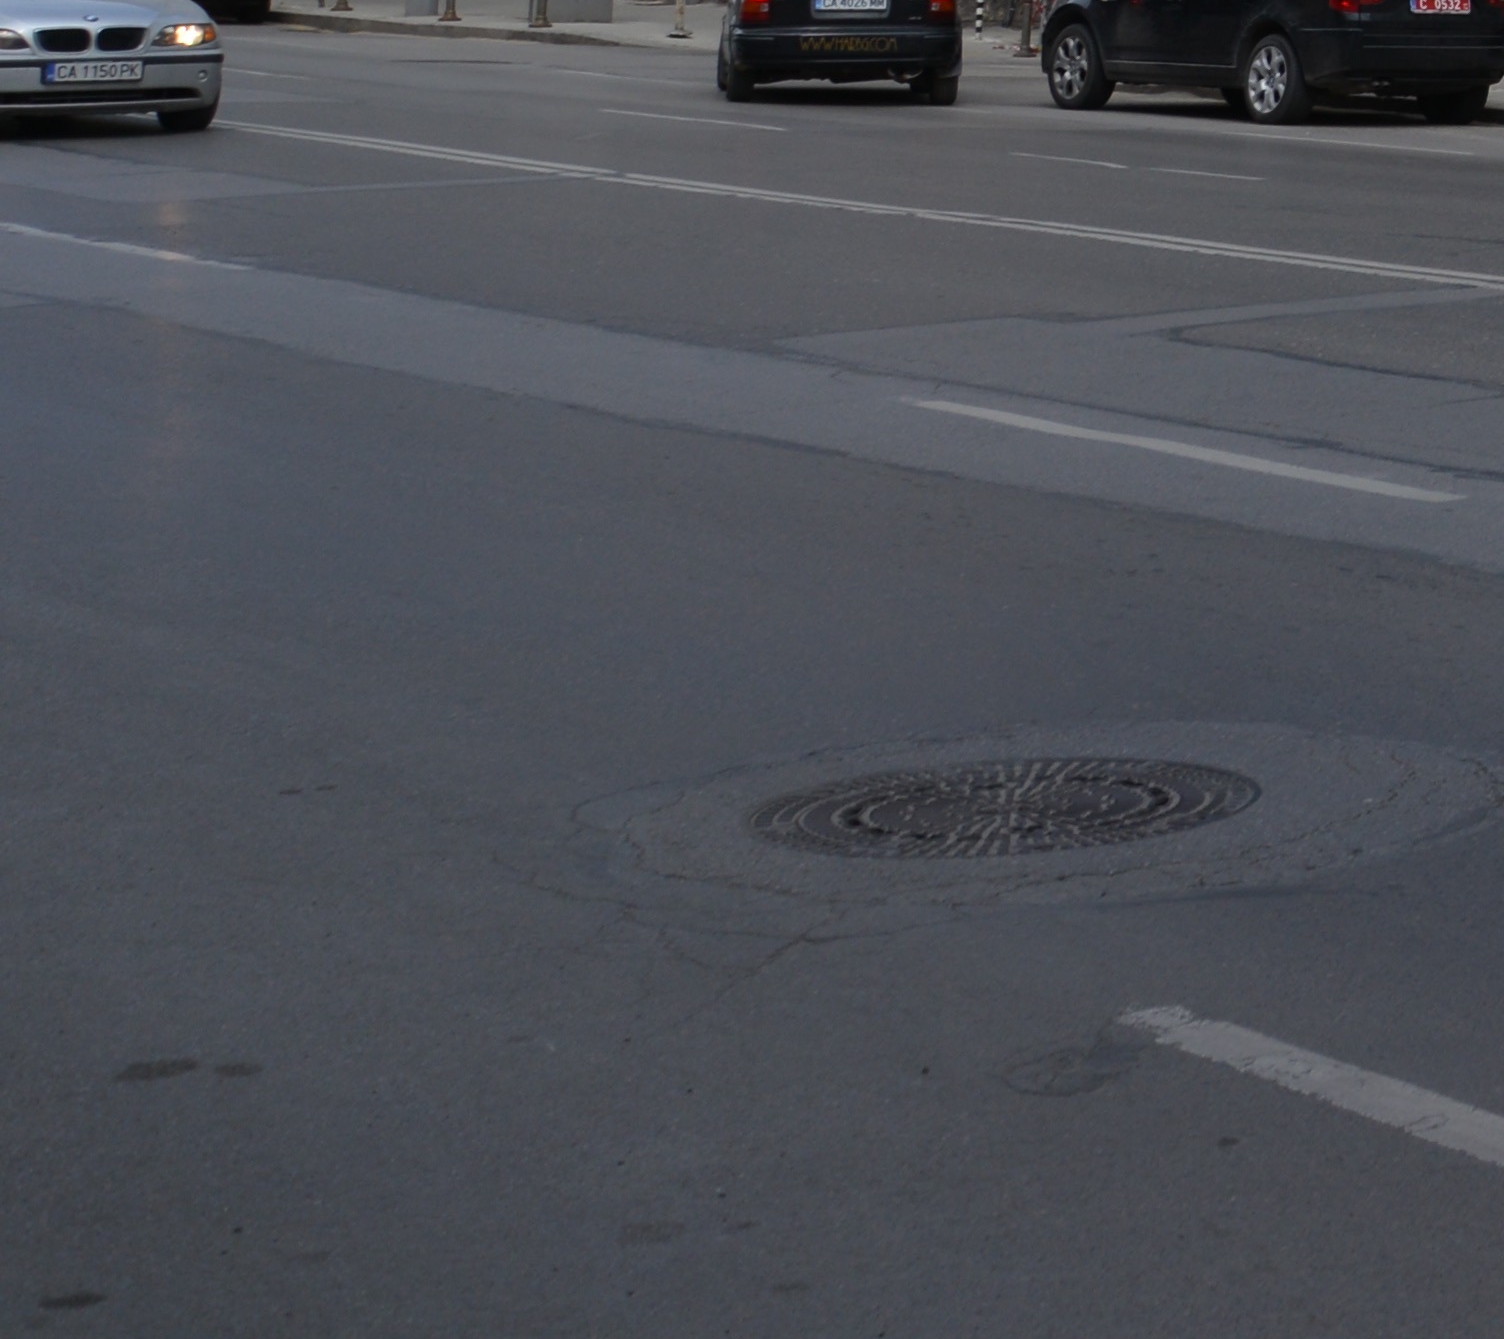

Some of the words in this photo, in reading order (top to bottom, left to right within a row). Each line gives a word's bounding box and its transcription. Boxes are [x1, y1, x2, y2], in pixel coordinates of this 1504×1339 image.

[57, 65, 77, 79] CA
[82, 64, 117, 78] 1150
[120, 63, 139, 77] PK
